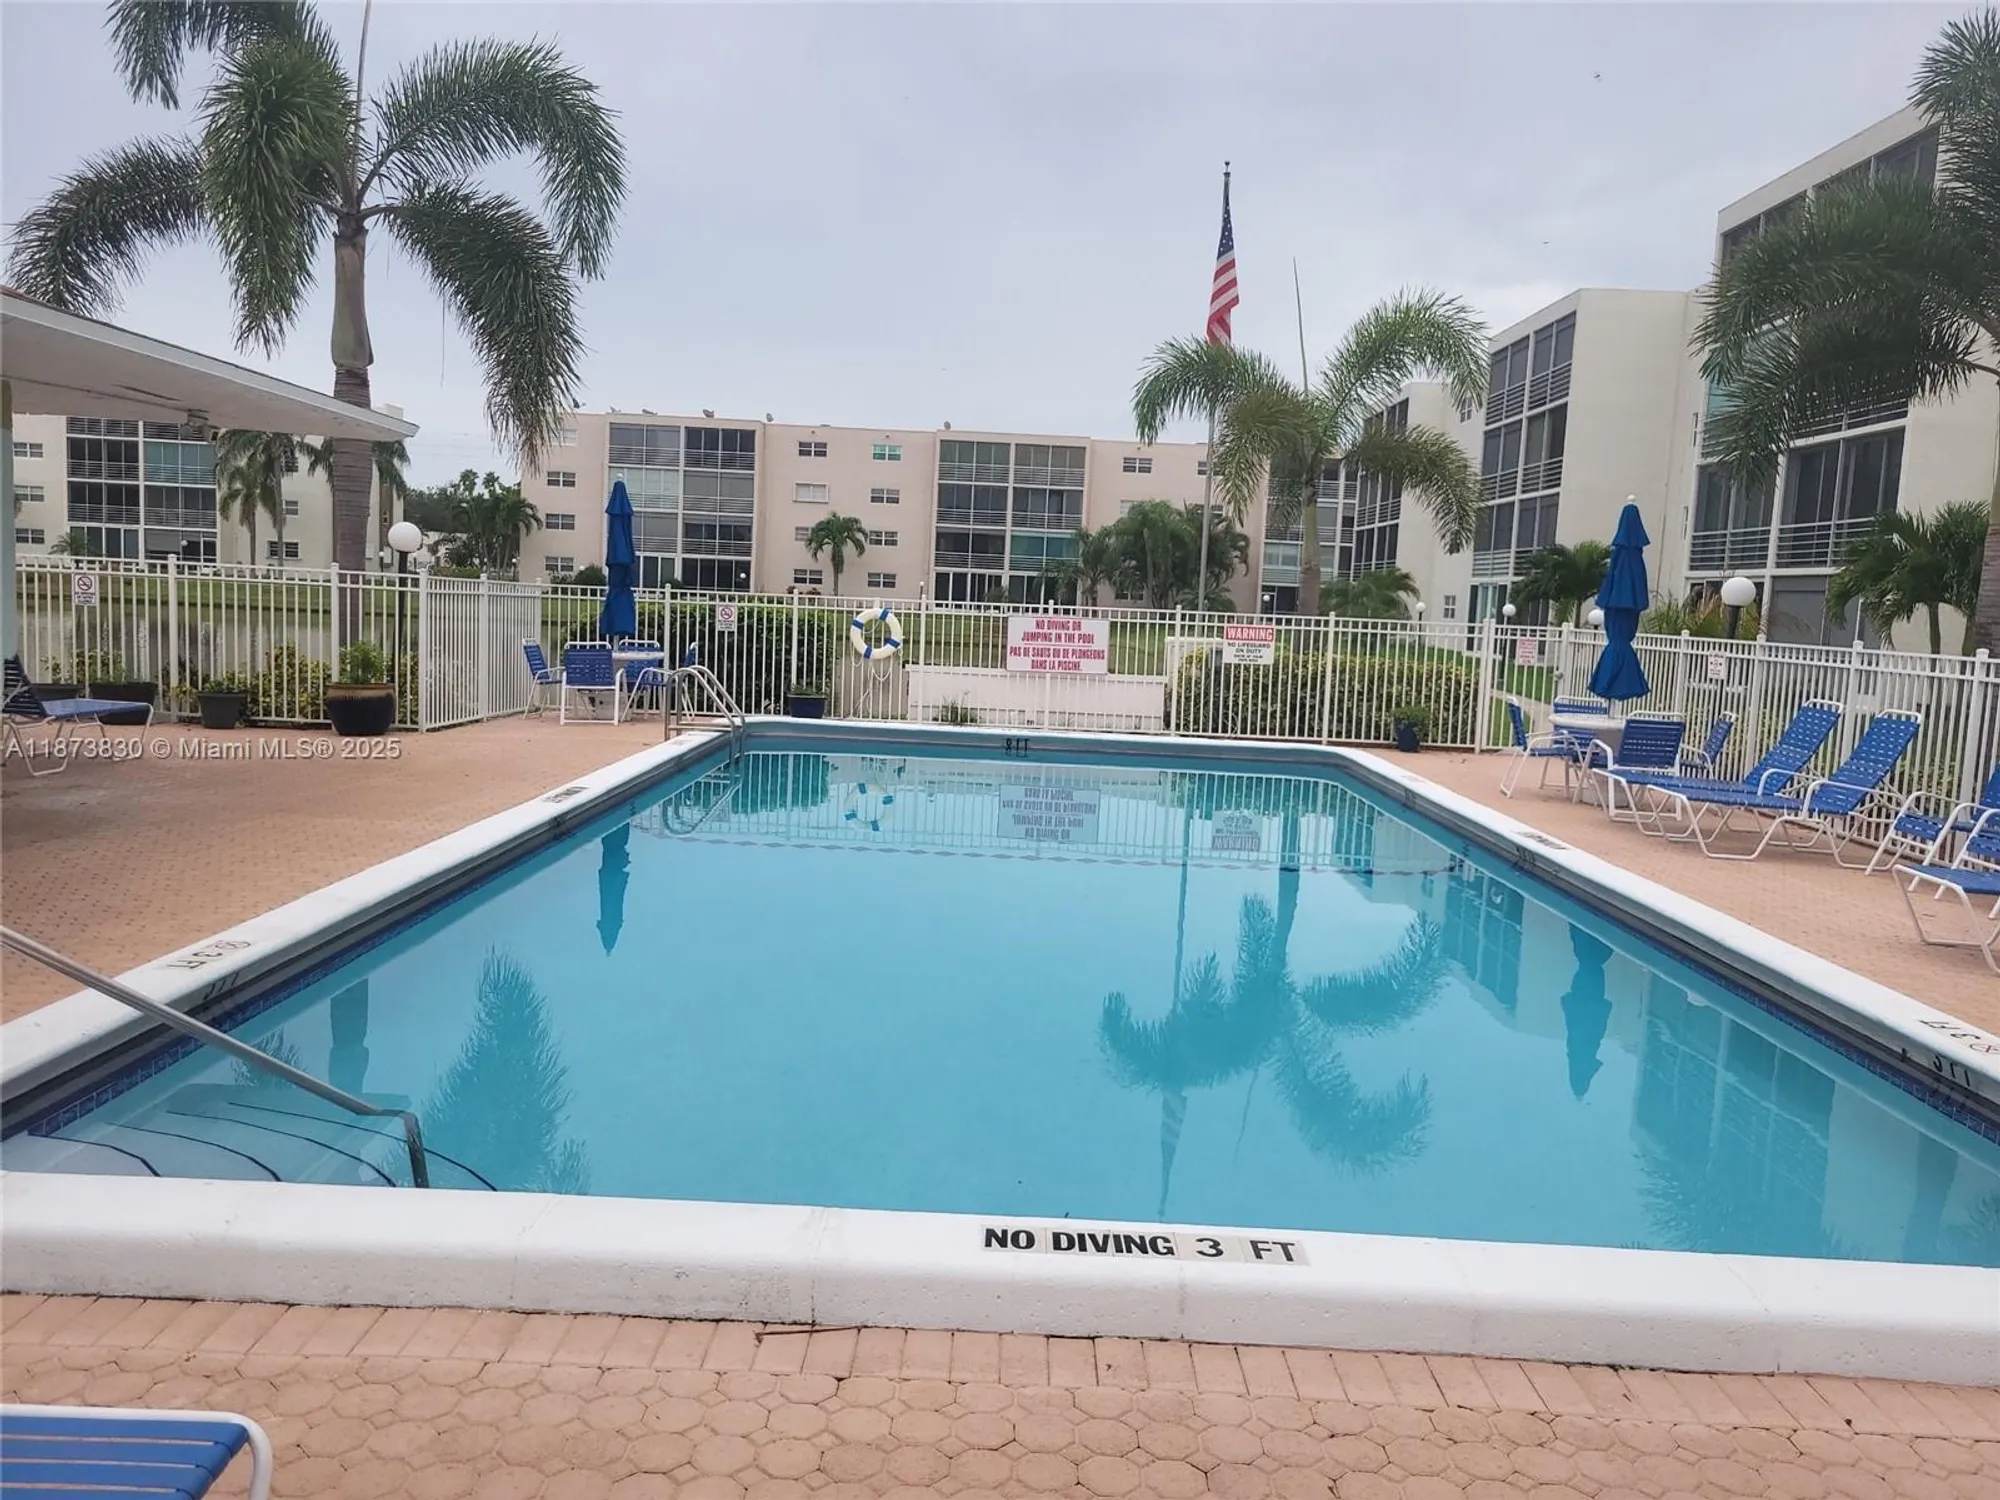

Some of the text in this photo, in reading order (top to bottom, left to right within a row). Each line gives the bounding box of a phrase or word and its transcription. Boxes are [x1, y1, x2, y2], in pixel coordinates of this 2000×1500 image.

[1035, 620, 1082, 631] NO DIVING OR
[1022, 631, 1095, 644] JUMPING IN THE POOL
[1227, 627, 1273, 641] WARNING
[1009, 646, 1105, 660] PAS DE SAUTS OU DE PLONGEONS
[1031, 660, 1047, 670] DANS
[1049, 660, 1056, 670] LA
[984, 1227, 1296, 1263] NO DIVING 3 FT
